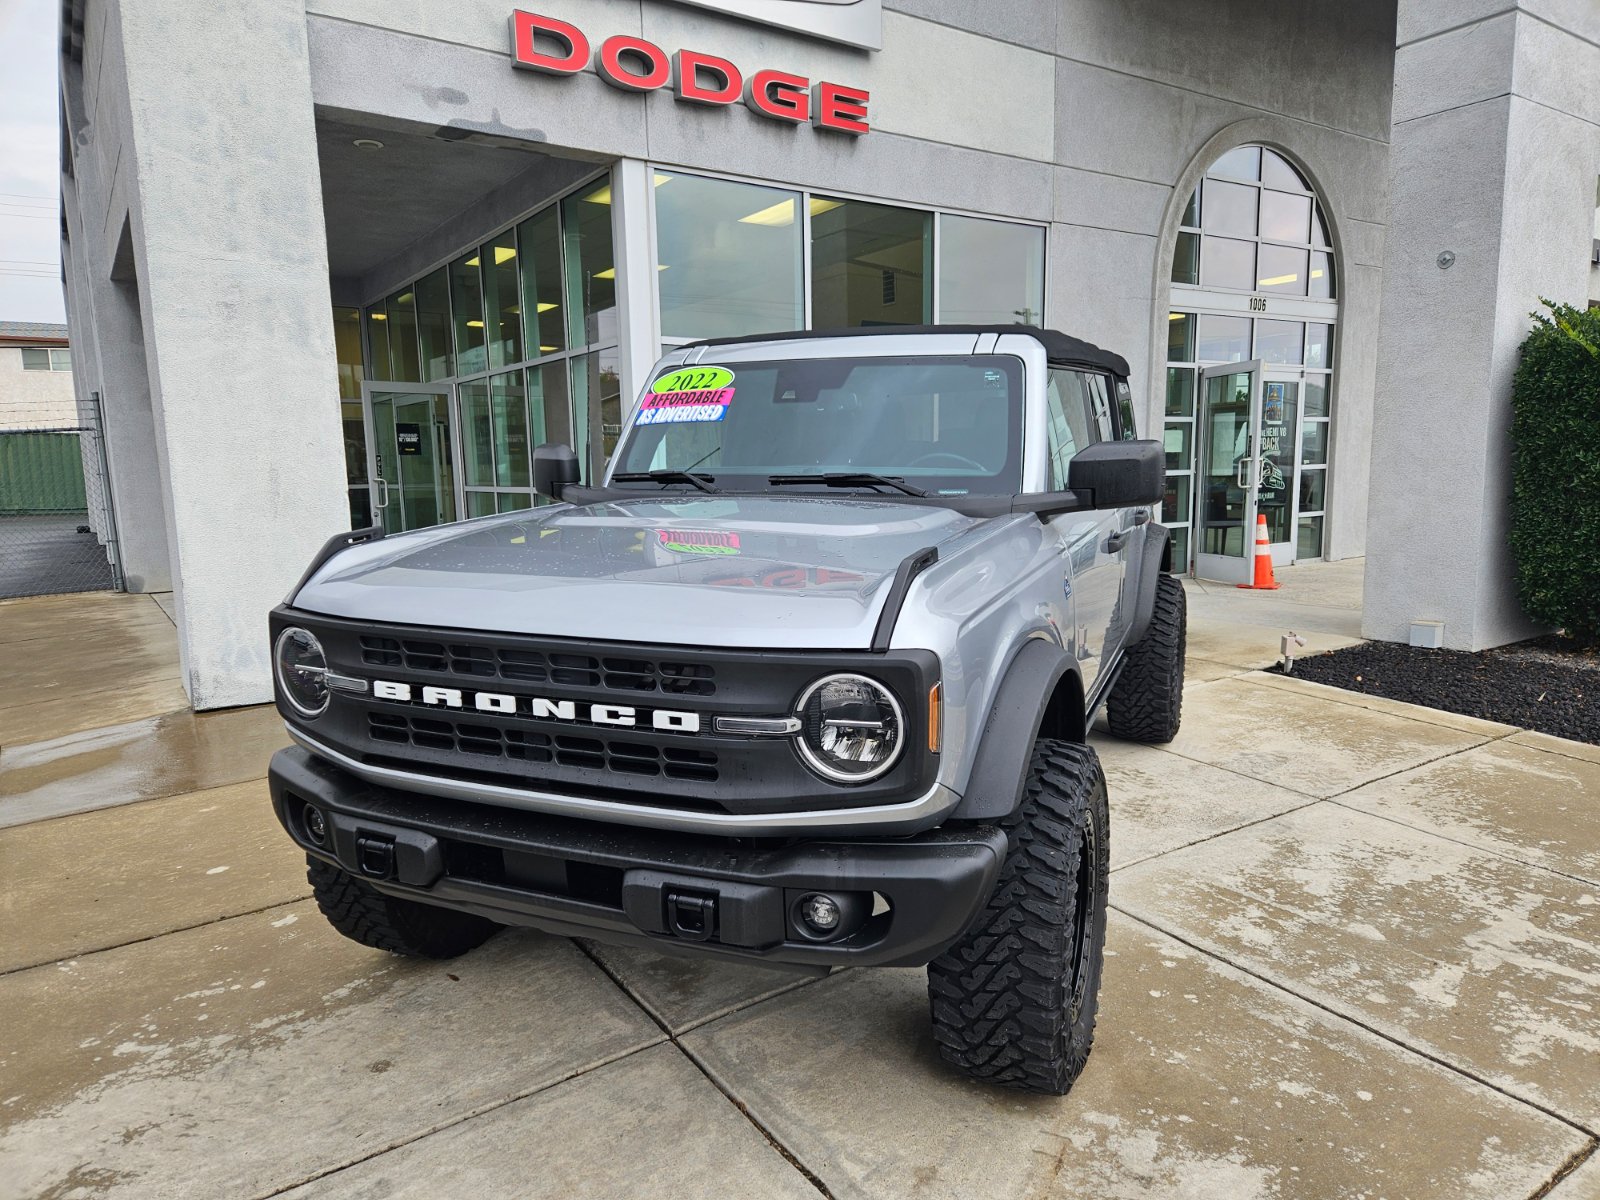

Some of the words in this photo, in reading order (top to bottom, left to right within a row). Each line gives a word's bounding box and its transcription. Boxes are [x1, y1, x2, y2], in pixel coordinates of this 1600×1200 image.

[509, 9, 870, 135] DODGE
[1249, 297, 1266, 312] 1006
[666, 372, 718, 392] 2022
[648, 390, 727, 407] AFFORDABLE
[635, 409, 656, 425] AS
[654, 405, 724, 423] ADVERTISED
[1266, 427, 1279, 437] HEMI
[1280, 427, 1287, 437] V8
[1262, 437, 1279, 451] BACK
[373, 680, 700, 732] BRONCO
